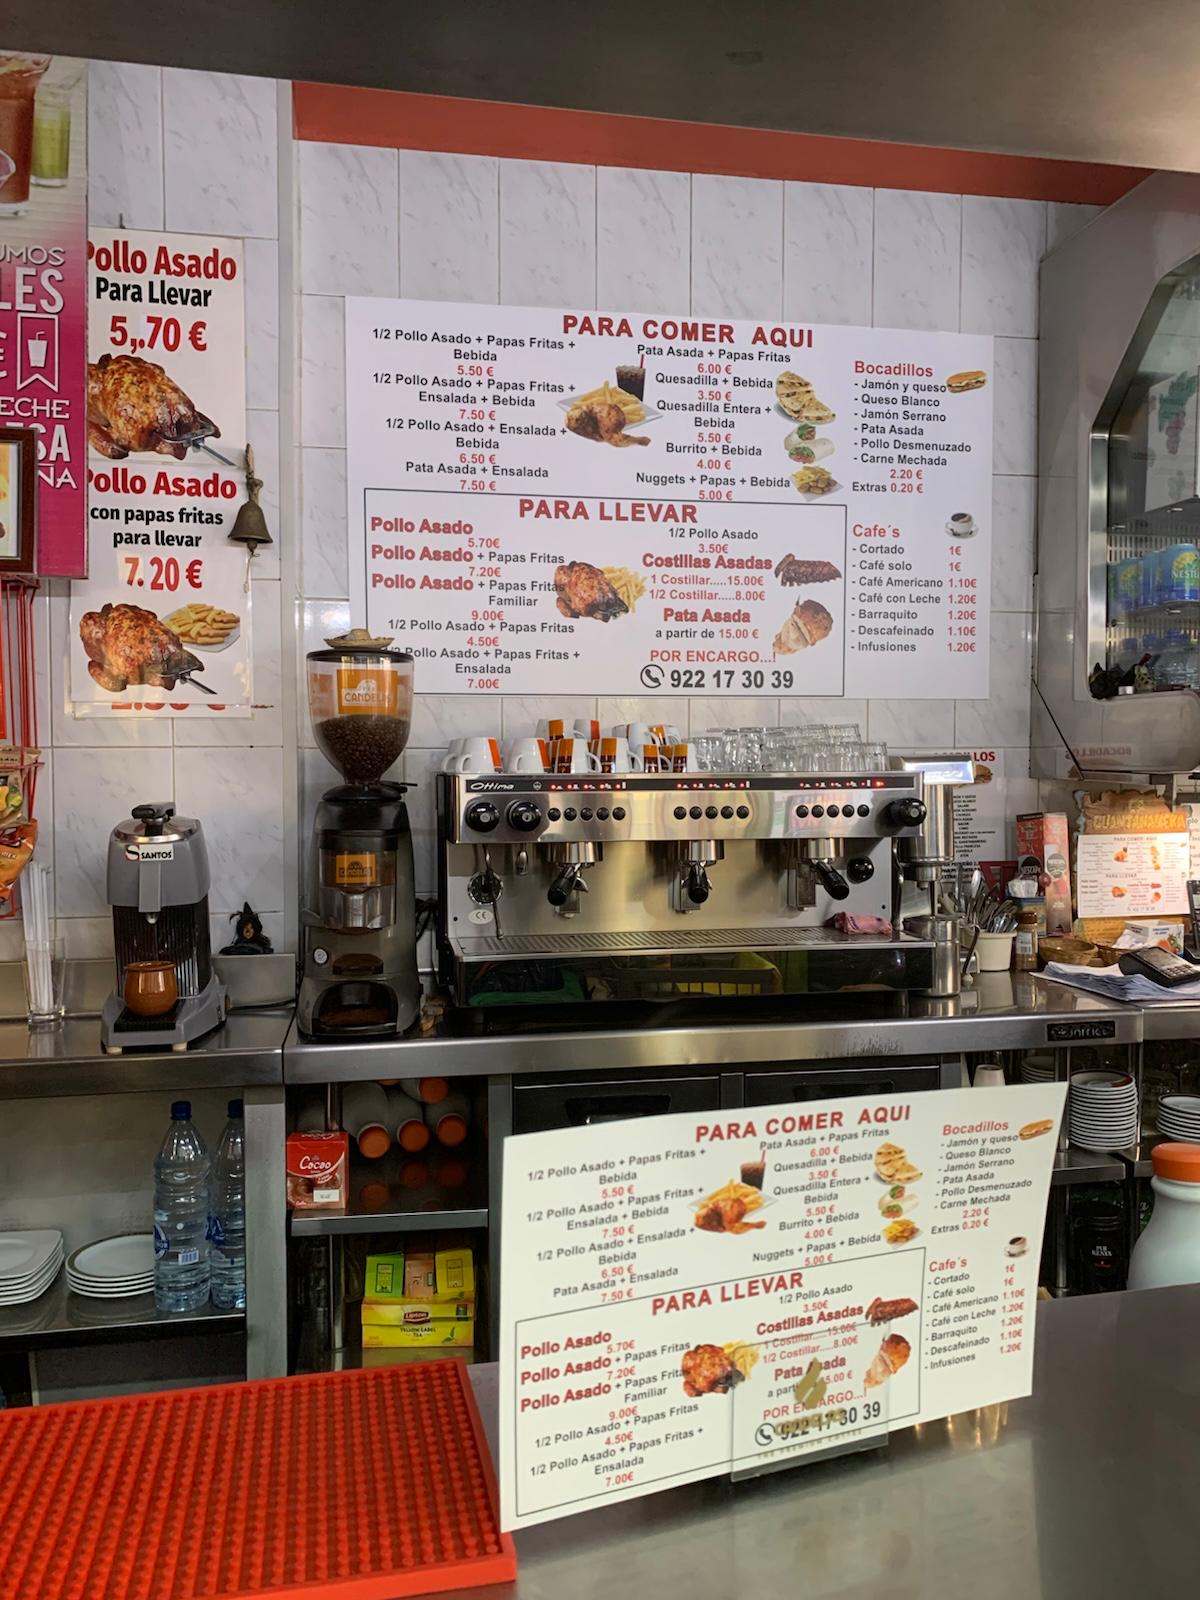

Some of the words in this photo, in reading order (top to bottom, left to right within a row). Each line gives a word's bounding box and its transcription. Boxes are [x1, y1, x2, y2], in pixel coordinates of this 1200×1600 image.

[154, 246, 237, 281] Asado
[96, 277, 143, 303] Para
[149, 280, 212, 307] Llevar
[188, 321, 207, 352] €
[563, 314, 633, 338] PARA
[642, 319, 735, 344] COMER
[751, 326, 813, 348] AQUI
[372, 328, 391, 340] 1/2
[395, 329, 428, 342] Pollo
[431, 331, 472, 344] Asado
[487, 334, 525, 348] Papas
[529, 337, 564, 350] Fritas
[453, 348, 497, 361] Bebida
[637, 344, 663, 356] Pata
[666, 345, 704, 358] Asada
[718, 348, 754, 362] Papas
[758, 350, 791, 363] Fritas
[457, 364, 483, 377] 5.50
[697, 362, 722, 374] 6.00
[854, 360, 933, 378] Bocadillos
[860, 378, 899, 390] Jamón
[902, 383, 909, 393] y
[912, 383, 947, 394] queso
[861, 393, 898, 405] Queso
[901, 395, 940, 407] Blanco
[860, 408, 899, 420] Jamón
[902, 409, 946, 422] Serrano
[861, 422, 886, 434] Pata
[888, 424, 924, 436] Asada
[860, 437, 890, 449] Pollo
[893, 439, 972, 452] Desmenuzado
[860, 452, 894, 464] Carne
[897, 454, 947, 466] Mechada
[889, 468, 913, 479] 2.20
[153, 472, 237, 499] Asado
[852, 481, 887, 493] Extras
[890, 482, 913, 493] 0.20
[91, 507, 120, 520] con
[124, 508, 175, 526] papas
[178, 507, 224, 525] fritas
[519, 498, 589, 520] PARA
[599, 501, 698, 523] LLEVAR
[371, 516, 415, 533] Pollo
[418, 518, 473, 535] Asado
[113, 531, 150, 548] para
[155, 530, 202, 547] llevar
[668, 527, 685, 538] 1/2
[688, 527, 719, 539] Pollo
[721, 528, 758, 540] Asado
[467, 537, 500, 549] 5.70€
[698, 543, 728, 554] 3.50€
[859, 543, 905, 555] Cortado
[948, 545, 961, 556] 1€
[642, 552, 711, 569] Costillas
[714, 554, 773, 570] Asadas
[859, 559, 885, 570] Café
[887, 560, 912, 571] solo
[948, 561, 961, 572] 1€
[186, 559, 203, 589] €
[650, 573, 656, 584] 1
[858, 575, 883, 587] Café
[885, 576, 943, 588] Americano
[948, 577, 977, 588] 1.10€
[649, 588, 666, 599] 1/2
[858, 592, 883, 603] Café
[885, 594, 906, 604] con
[908, 593, 941, 604] Leche
[948, 593, 976, 604] 1.20€
[663, 607, 698, 622] Pata
[701, 608, 751, 623] Asada
[858, 608, 918, 622] Barraquito
[947, 609, 976, 621] 1.20€
[655, 629, 662, 638] a
[665, 627, 698, 640] partir
[700, 628, 715, 639] de
[719, 628, 749, 639] 15.00
[858, 624, 934, 636] Descafeinado
[947, 625, 976, 637] 1.10€
[857, 640, 916, 652] Infusiones
[947, 641, 976, 652] 1.20€
[650, 649, 681, 662] POR
[670, 669, 705, 688] 922
[712, 669, 735, 688] 17
[741, 670, 764, 689] 30
[771, 670, 793, 689] 39
[141, 851, 172, 859] SANTOS
[695, 1120, 757, 1143] PARA
[765, 1111, 843, 1136] COMER
[857, 1104, 910, 1125] AQUI
[942, 1120, 1009, 1136] Bocadillos
[946, 1137, 979, 1148] Jamón
[980, 1137, 987, 1147] y
[989, 1130, 1019, 1145] queso
[945, 1150, 976, 1161] Queso
[978, 1146, 1012, 1157] Blanco
[299, 1155, 332, 1170] Cacao
[930, 1224, 960, 1235] Extras
[933, 1272, 970, 1286] Cortado
[652, 1288, 712, 1316] PARA
[720, 1271, 803, 1303] LLEVAR
[520, 1341, 560, 1360] Pollo
[563, 1330, 612, 1351] Asado
[520, 1366, 560, 1385] Pollo
[563, 1355, 612, 1377] Asado
[624, 1349, 657, 1362] Papas
[660, 1342, 690, 1354] Fritas
[594, 1455, 644, 1475] Ensalada
